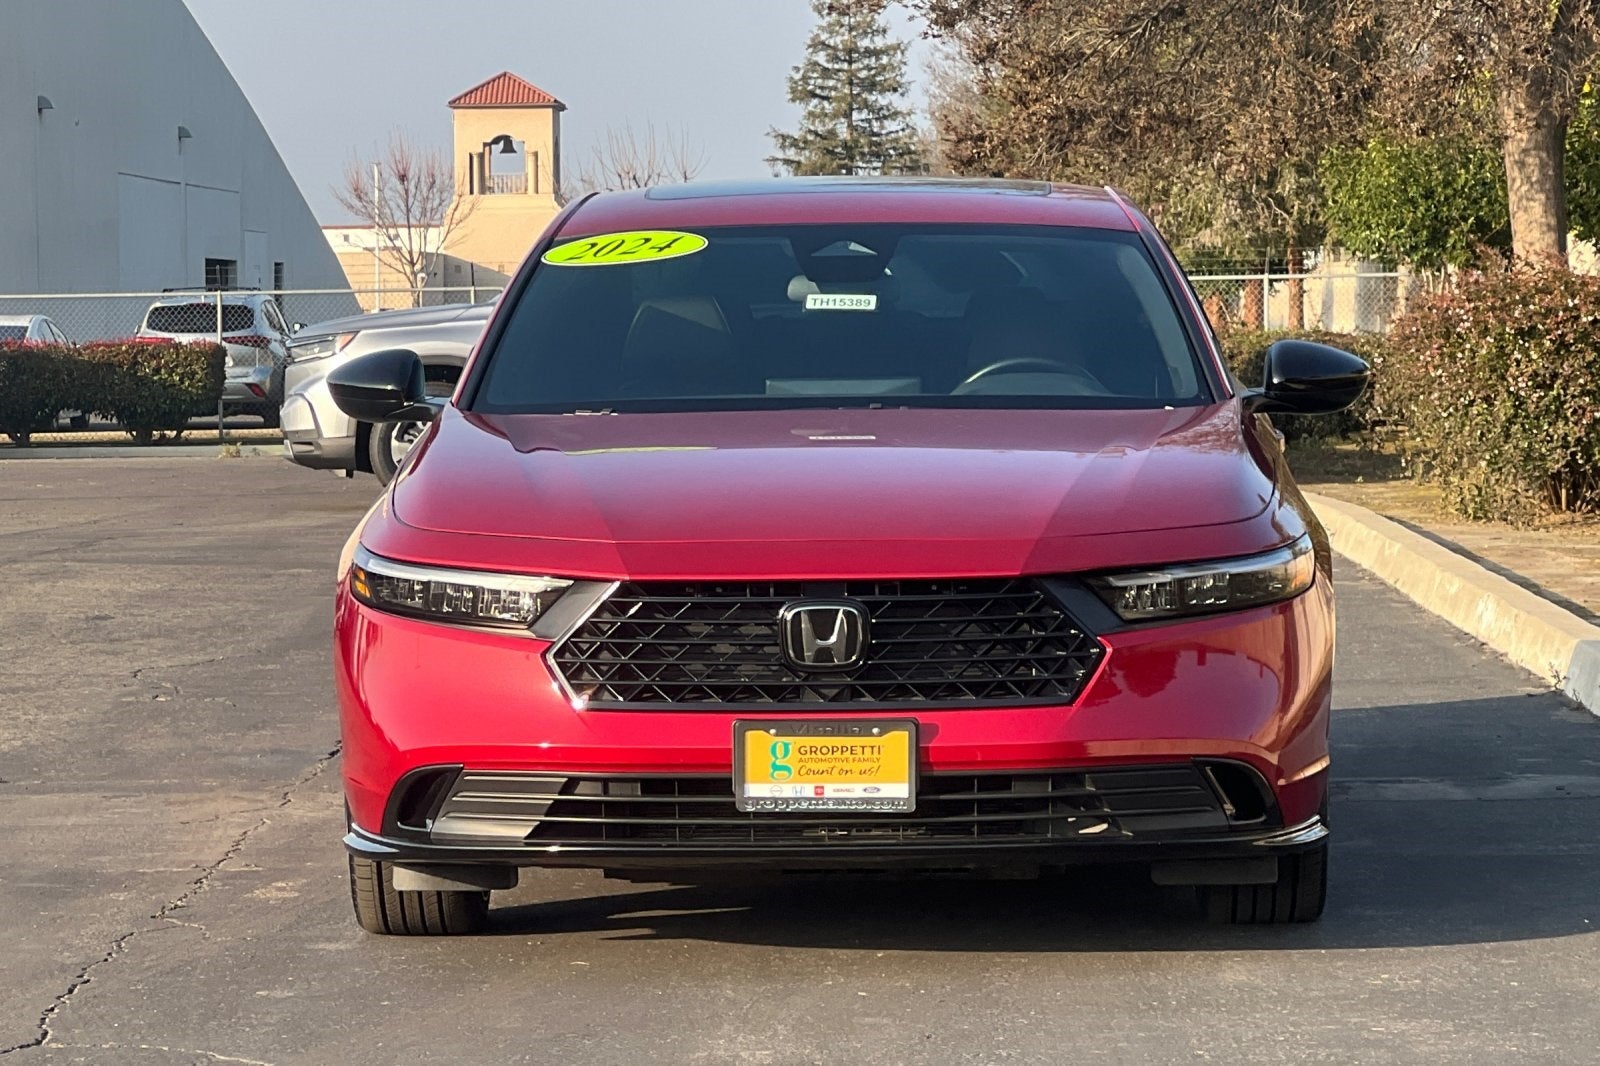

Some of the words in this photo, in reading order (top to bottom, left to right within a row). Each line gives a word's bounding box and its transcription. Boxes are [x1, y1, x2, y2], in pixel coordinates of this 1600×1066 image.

[563, 236, 684, 261] 2024
[811, 298, 871, 307] TH15389
[797, 745, 881, 756] GROPPETTI
[797, 764, 838, 777] Count
[839, 768, 855, 777] on
[859, 764, 880, 777] us!
